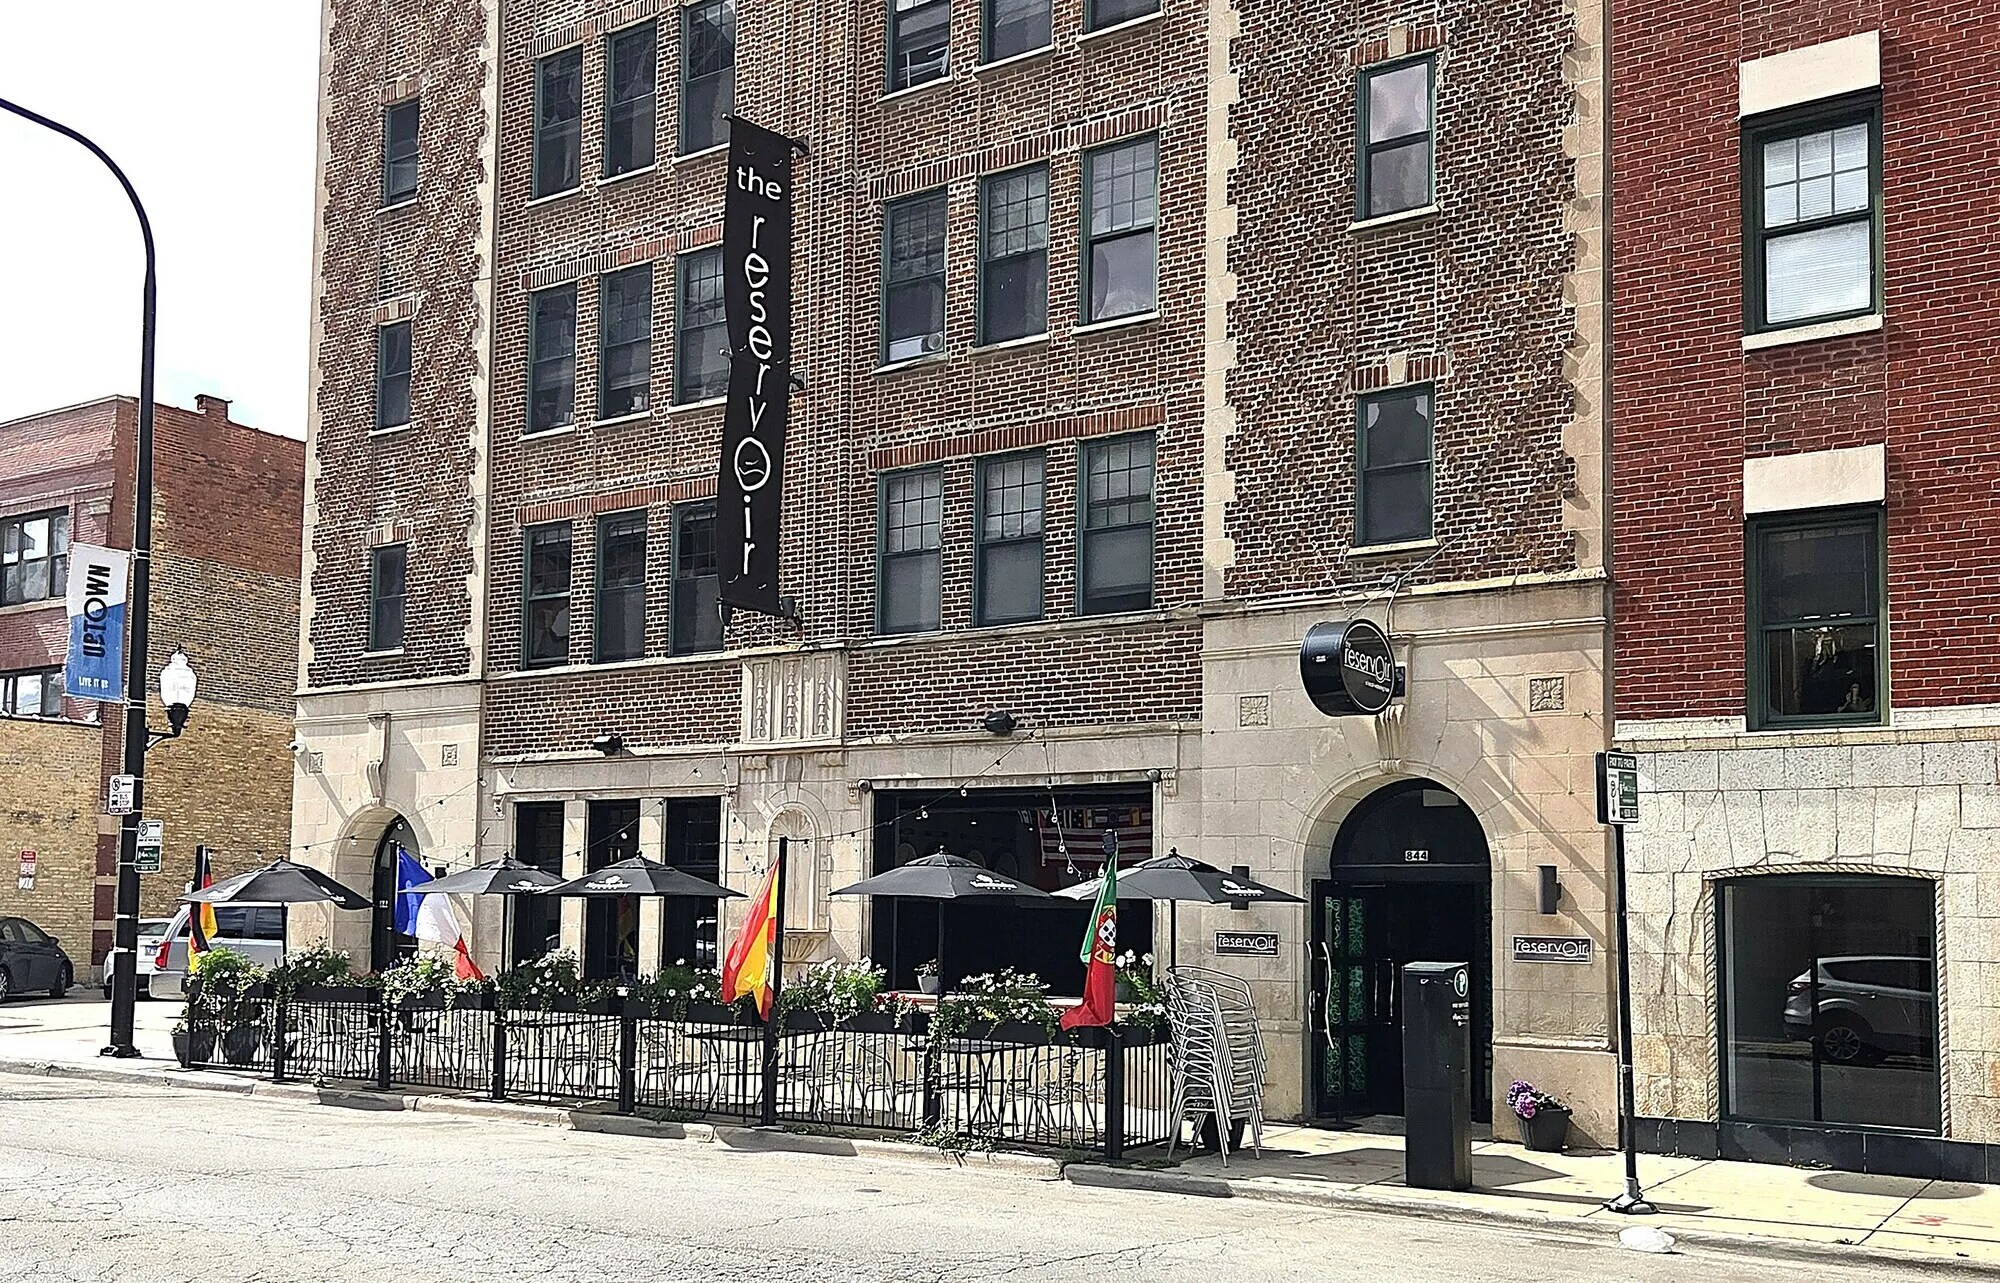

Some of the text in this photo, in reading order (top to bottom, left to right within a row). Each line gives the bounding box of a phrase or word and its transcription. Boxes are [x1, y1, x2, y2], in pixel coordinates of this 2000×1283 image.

[737, 165, 783, 201] the
[83, 564, 111, 658] UPTOWN
[1407, 851, 1427, 860] 844
